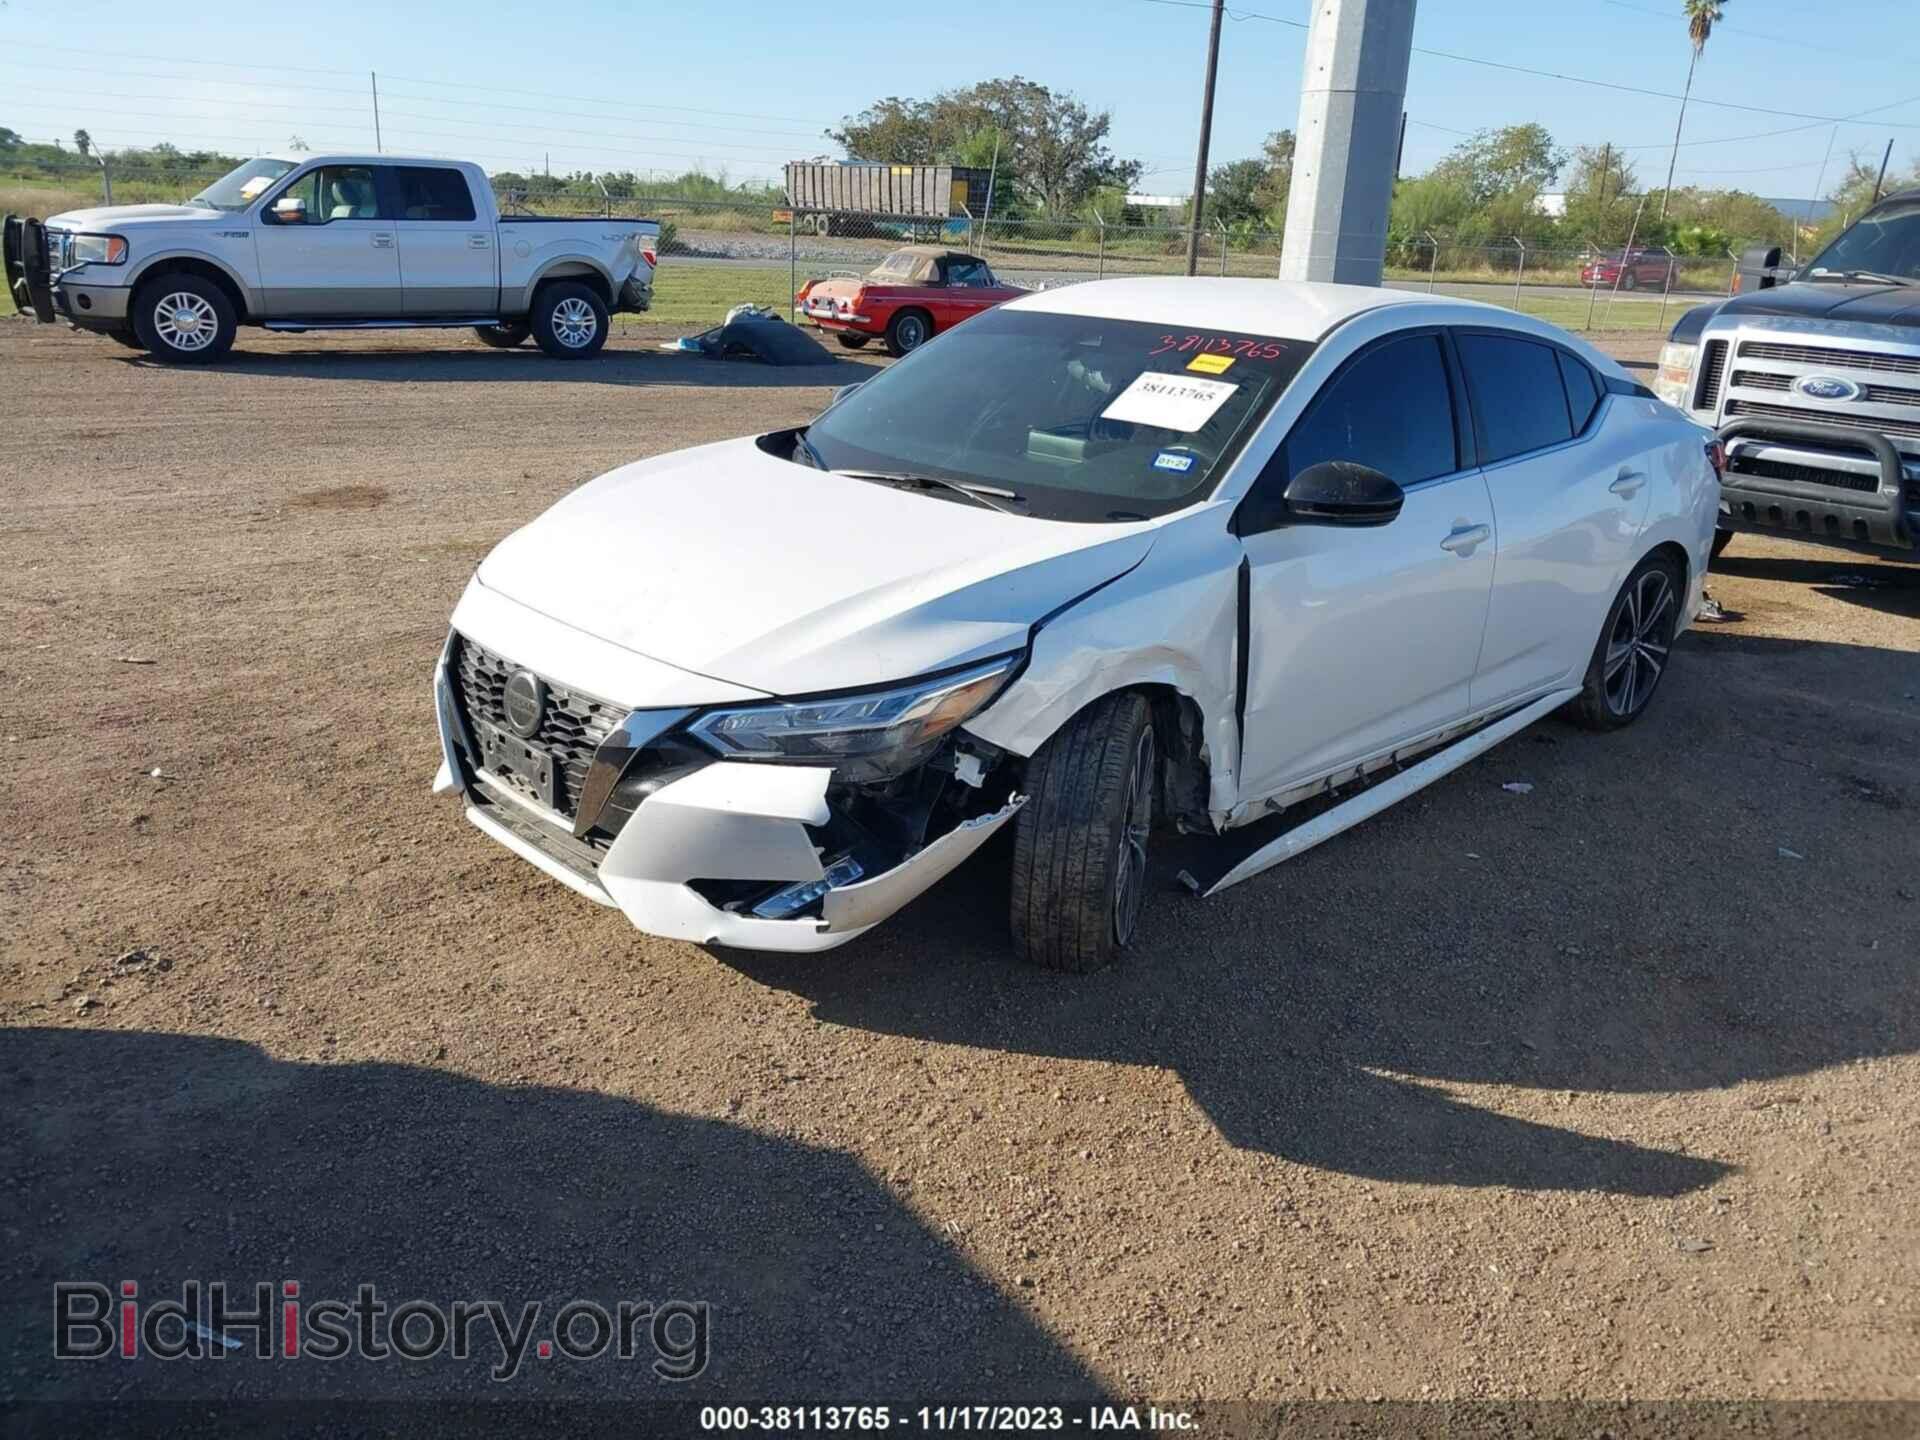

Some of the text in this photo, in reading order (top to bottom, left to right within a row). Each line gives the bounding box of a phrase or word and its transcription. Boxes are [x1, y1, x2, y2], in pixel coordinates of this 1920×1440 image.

[1148, 334, 1288, 359] 38113765
[1136, 383, 1216, 401] 38113765
[1809, 381, 1841, 396] Ford
